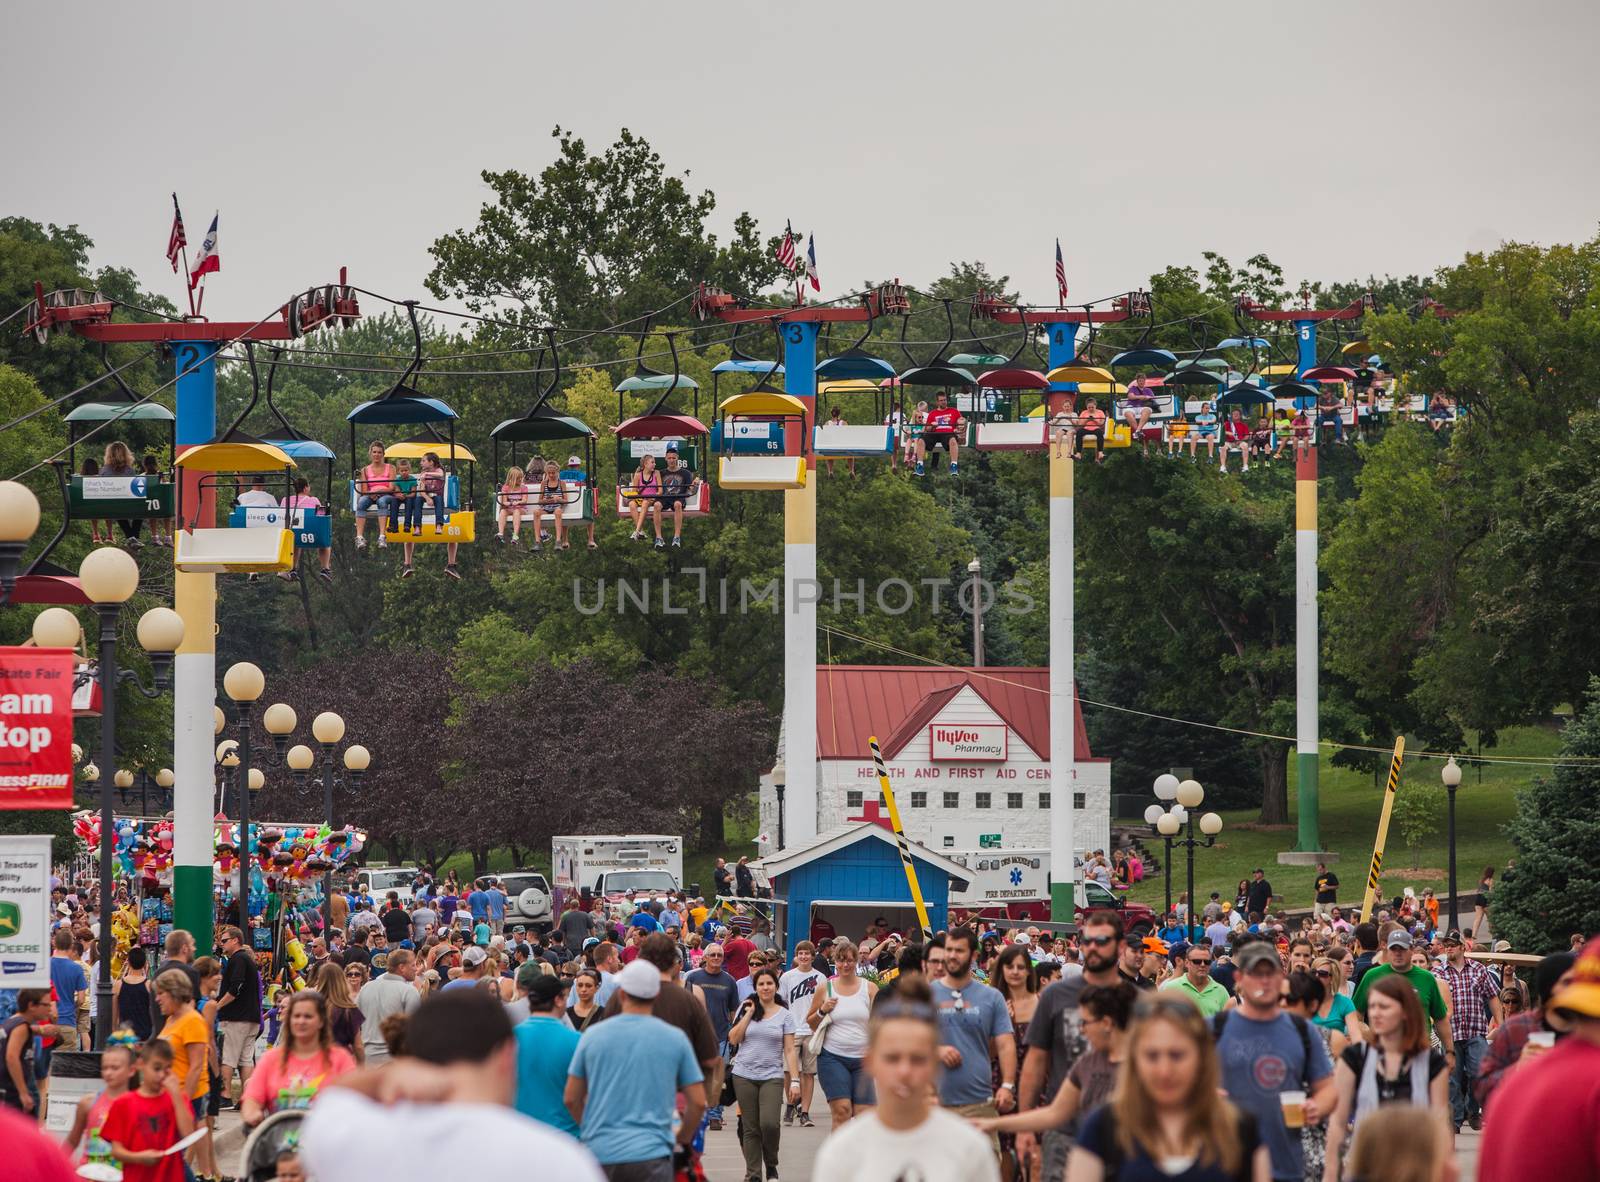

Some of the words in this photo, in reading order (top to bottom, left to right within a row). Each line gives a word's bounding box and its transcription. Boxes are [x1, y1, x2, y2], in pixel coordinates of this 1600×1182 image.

[790, 324, 803, 344] 3
[1055, 329, 1064, 346] 4
[1301, 325, 1310, 340] 5
[181, 346, 200, 373] 2
[993, 413, 1003, 421] 62
[767, 441, 778, 449] 65
[677, 460, 688, 468] 66
[145, 499, 160, 511] 70
[448, 526, 461, 536] 68
[301, 533, 315, 543] 69
[35, 668, 62, 679] Fair
[954, 744, 1002, 756] Pharmacy
[914, 768, 940, 778] AND
[949, 768, 985, 778] FIRST
[996, 769, 1017, 779] AID
[985, 890, 998, 898] FIRE
[999, 889, 1037, 898] DEPARTMENT
